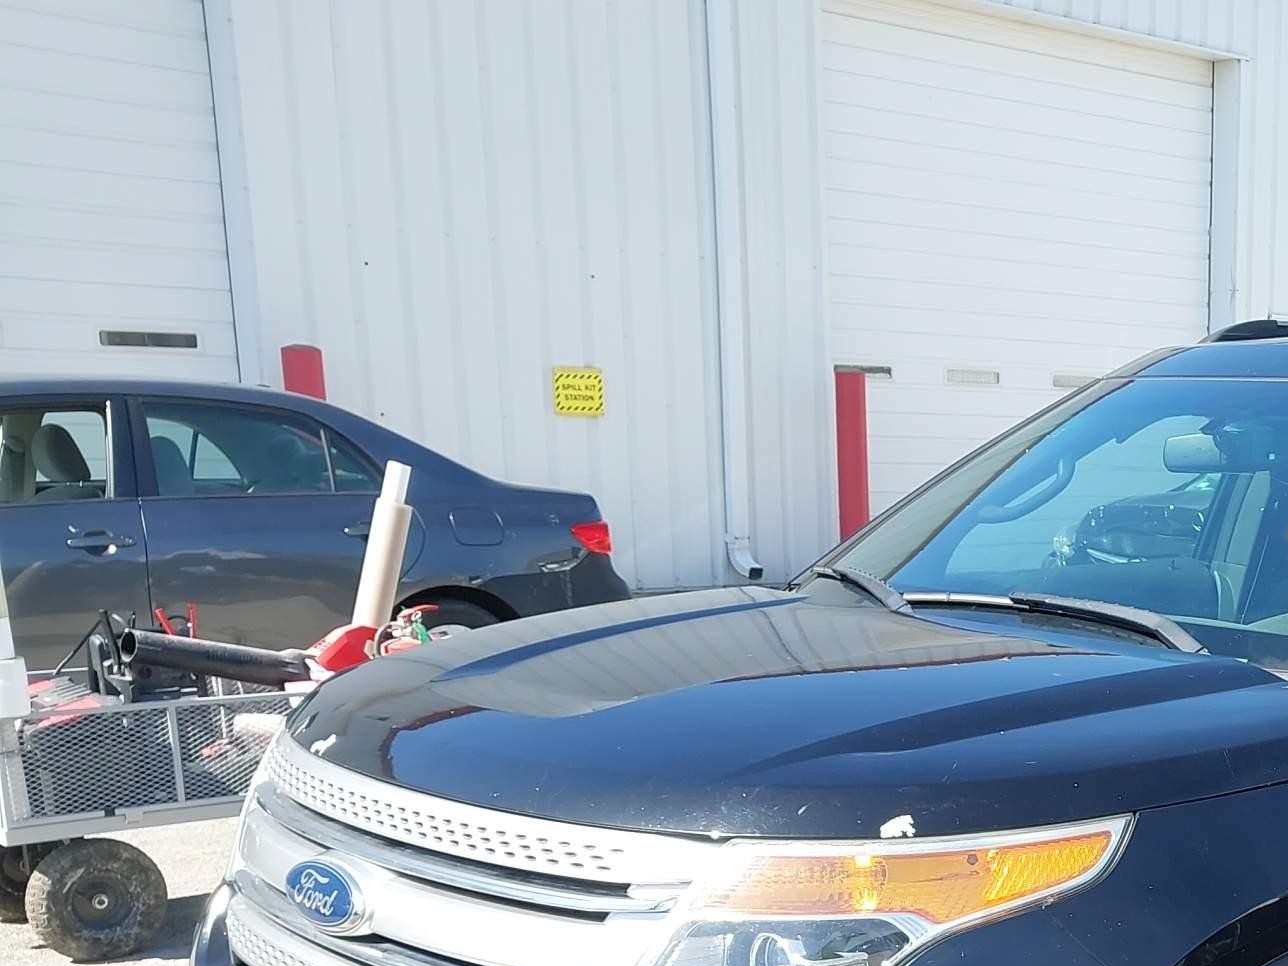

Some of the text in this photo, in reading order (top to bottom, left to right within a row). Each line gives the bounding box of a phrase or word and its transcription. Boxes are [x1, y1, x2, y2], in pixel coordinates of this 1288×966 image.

[561, 383, 583, 391] SPILL
[564, 393, 595, 401] STATION
[294, 868, 339, 916] Ford
